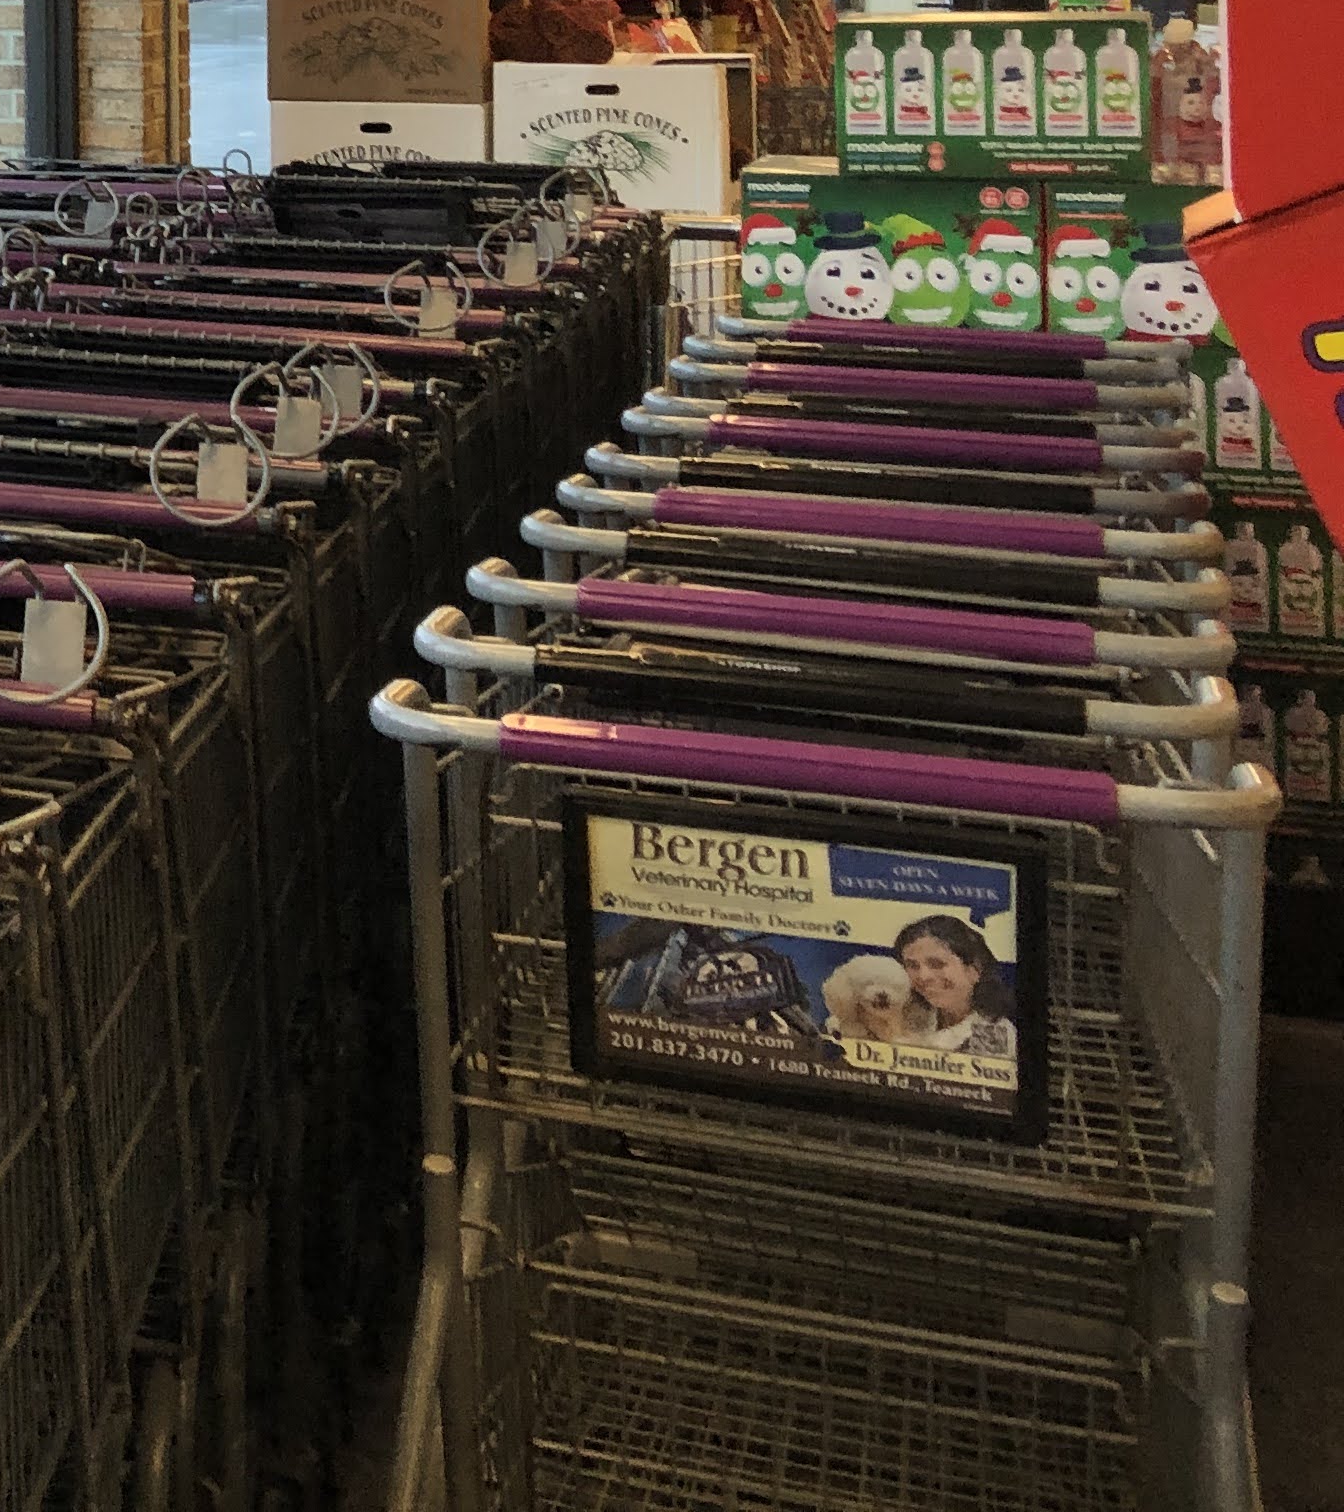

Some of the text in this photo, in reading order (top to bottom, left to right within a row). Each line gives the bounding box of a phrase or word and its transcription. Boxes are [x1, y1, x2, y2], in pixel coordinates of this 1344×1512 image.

[528, 107, 682, 141] SCENTED PINE CONES
[631, 821, 811, 882] Bergen
[630, 866, 814, 903] Veterinary Hospital
[658, 900, 704, 919] Other
[710, 906, 761, 927] Family
[768, 914, 832, 934] Doctors
[607, 1012, 795, 1050] www.bergenvet.com
[611, 1031, 744, 1066] 201.837.3470
[814, 1063, 880, 1086] Teaneck
[924, 1079, 994, 1102] Teaneck
[855, 1042, 884, 1064] Dr.
[889, 1046, 966, 1075] Jennifer
